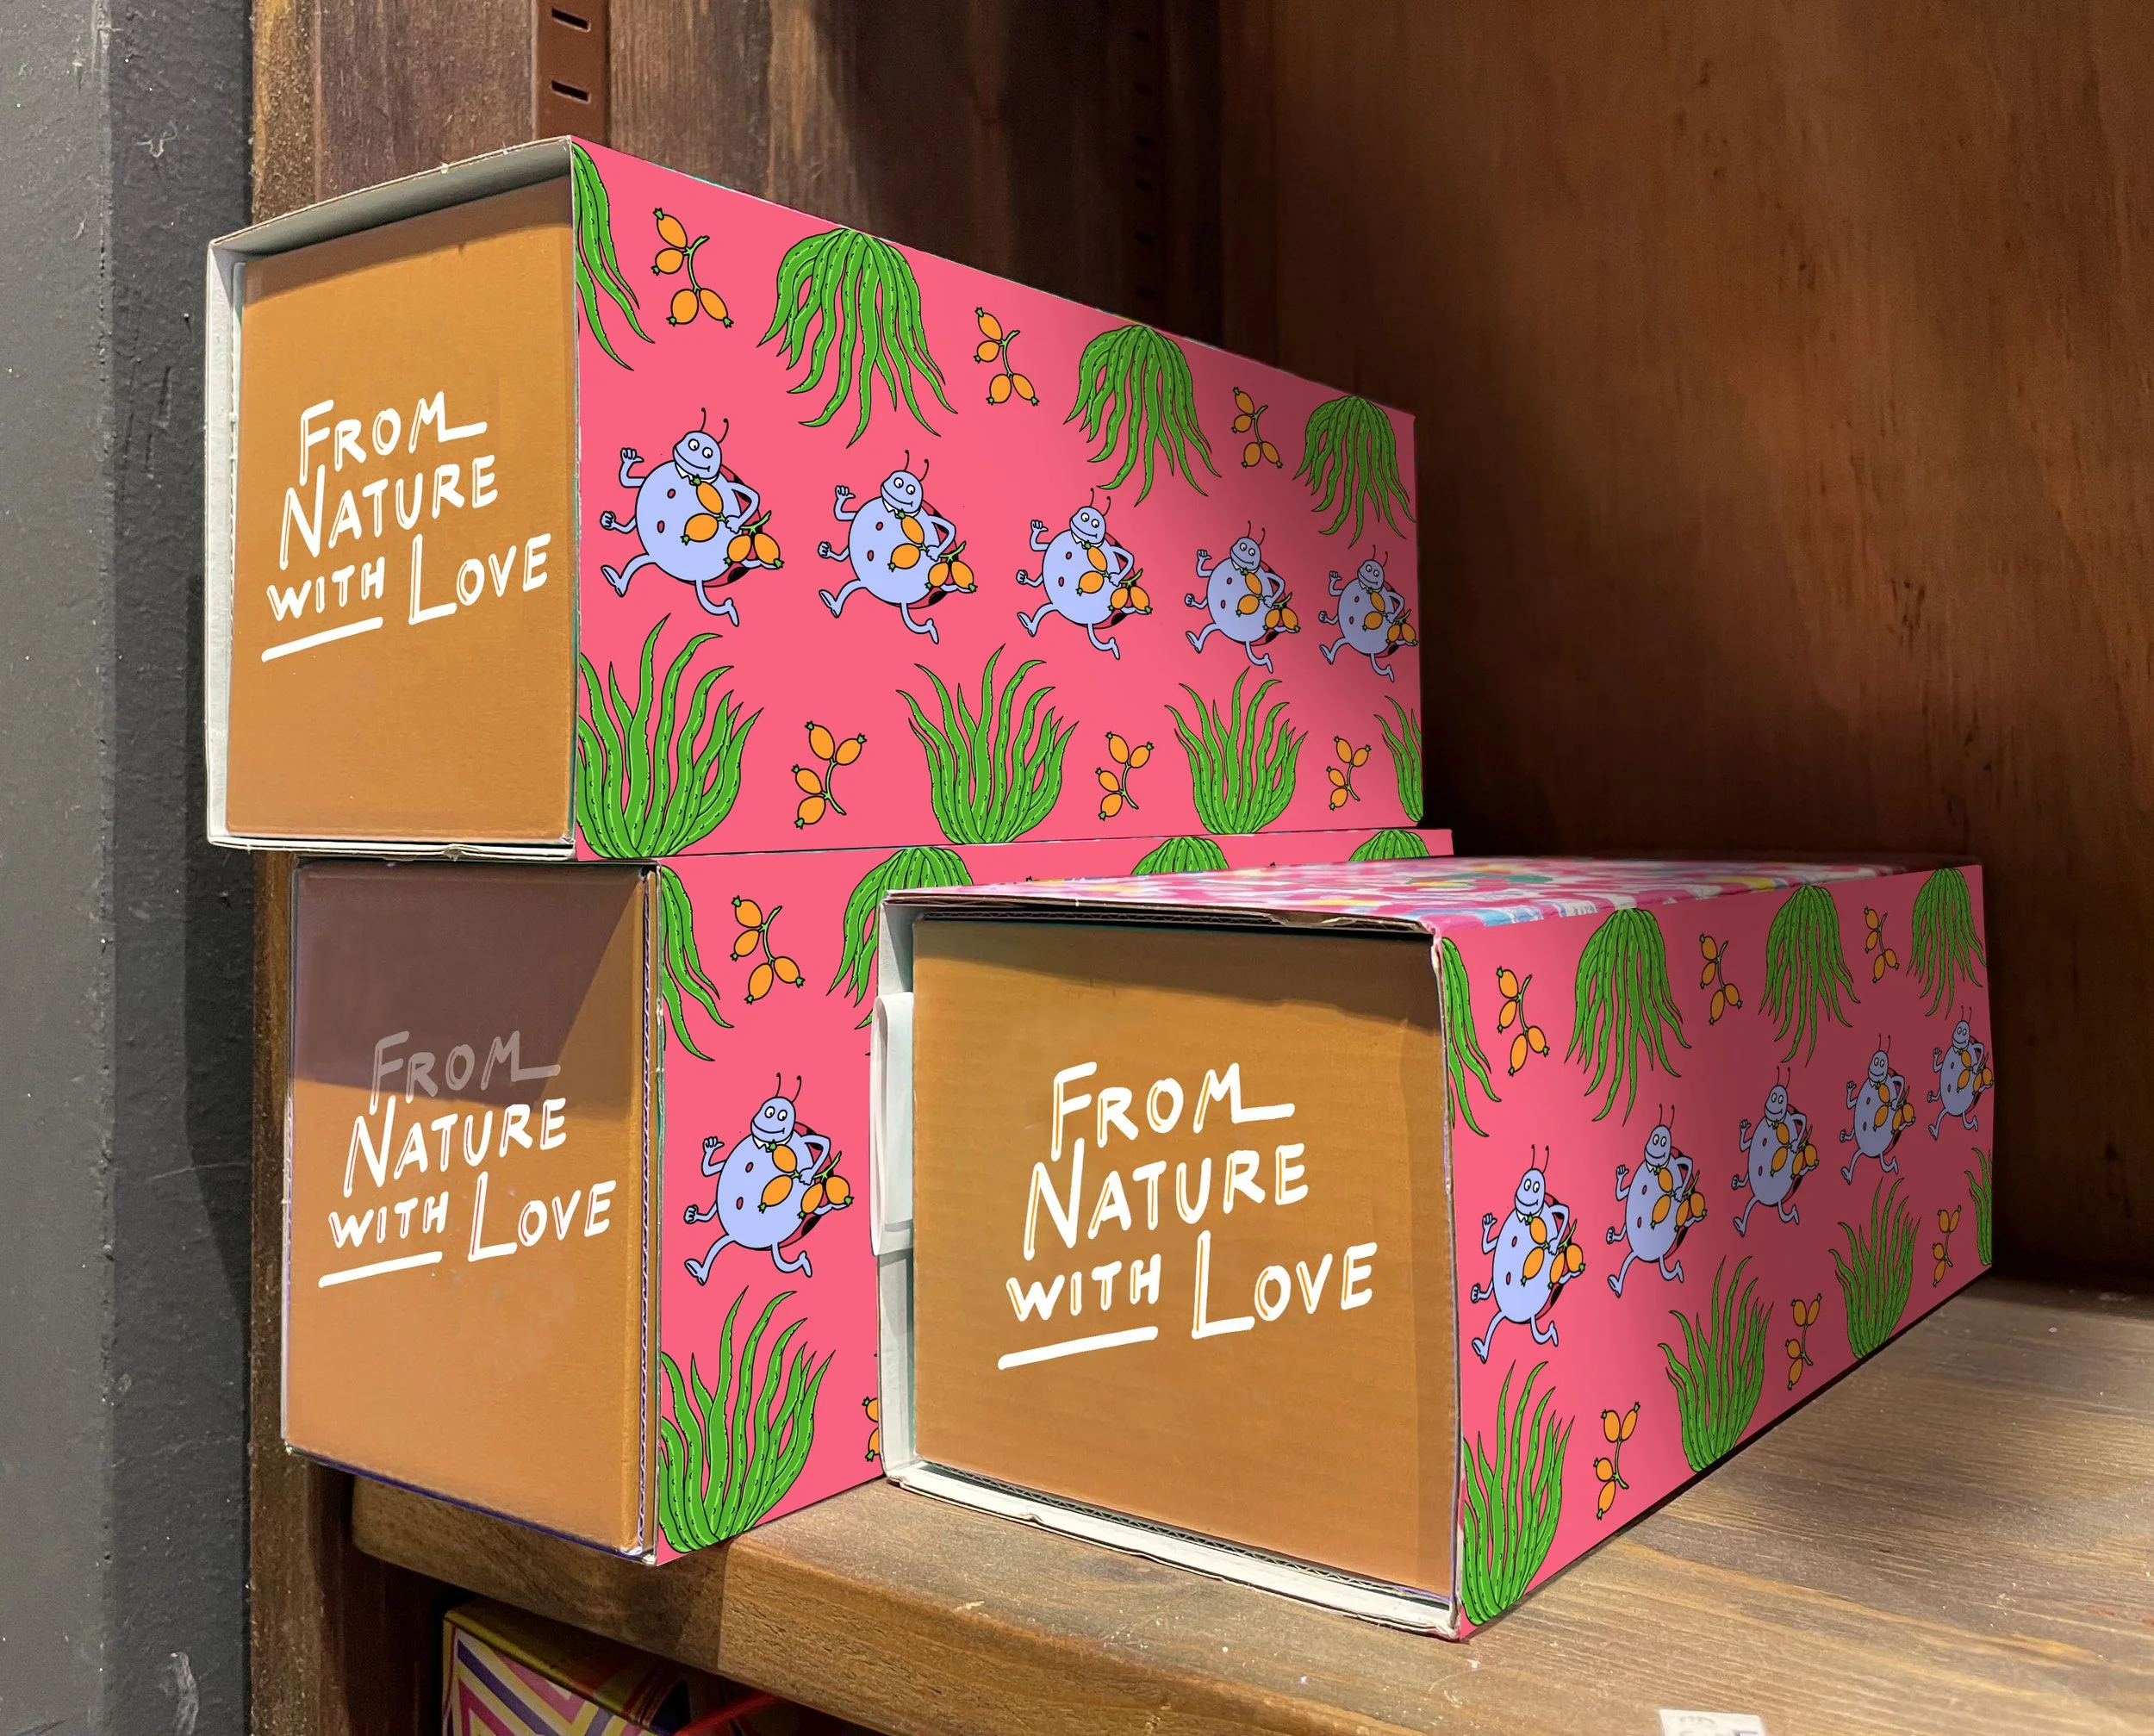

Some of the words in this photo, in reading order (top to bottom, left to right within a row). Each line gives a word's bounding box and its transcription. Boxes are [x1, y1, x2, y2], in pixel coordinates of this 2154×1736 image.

[299, 390, 488, 487] FROM
[279, 454, 498, 570] NATURE
[266, 556, 385, 621] WITH
[408, 533, 551, 625] LOVE
[369, 1030, 561, 1116] FROM
[1050, 1061, 1296, 1162] FROM
[343, 1096, 567, 1198] NATURE
[328, 1191, 449, 1248] WITH
[467, 1171, 617, 1262] LOVE
[1023, 1137, 1309, 1261] NATURE
[1005, 1253, 1161, 1322] WITH
[1191, 1229, 1378, 1340] LOVE
